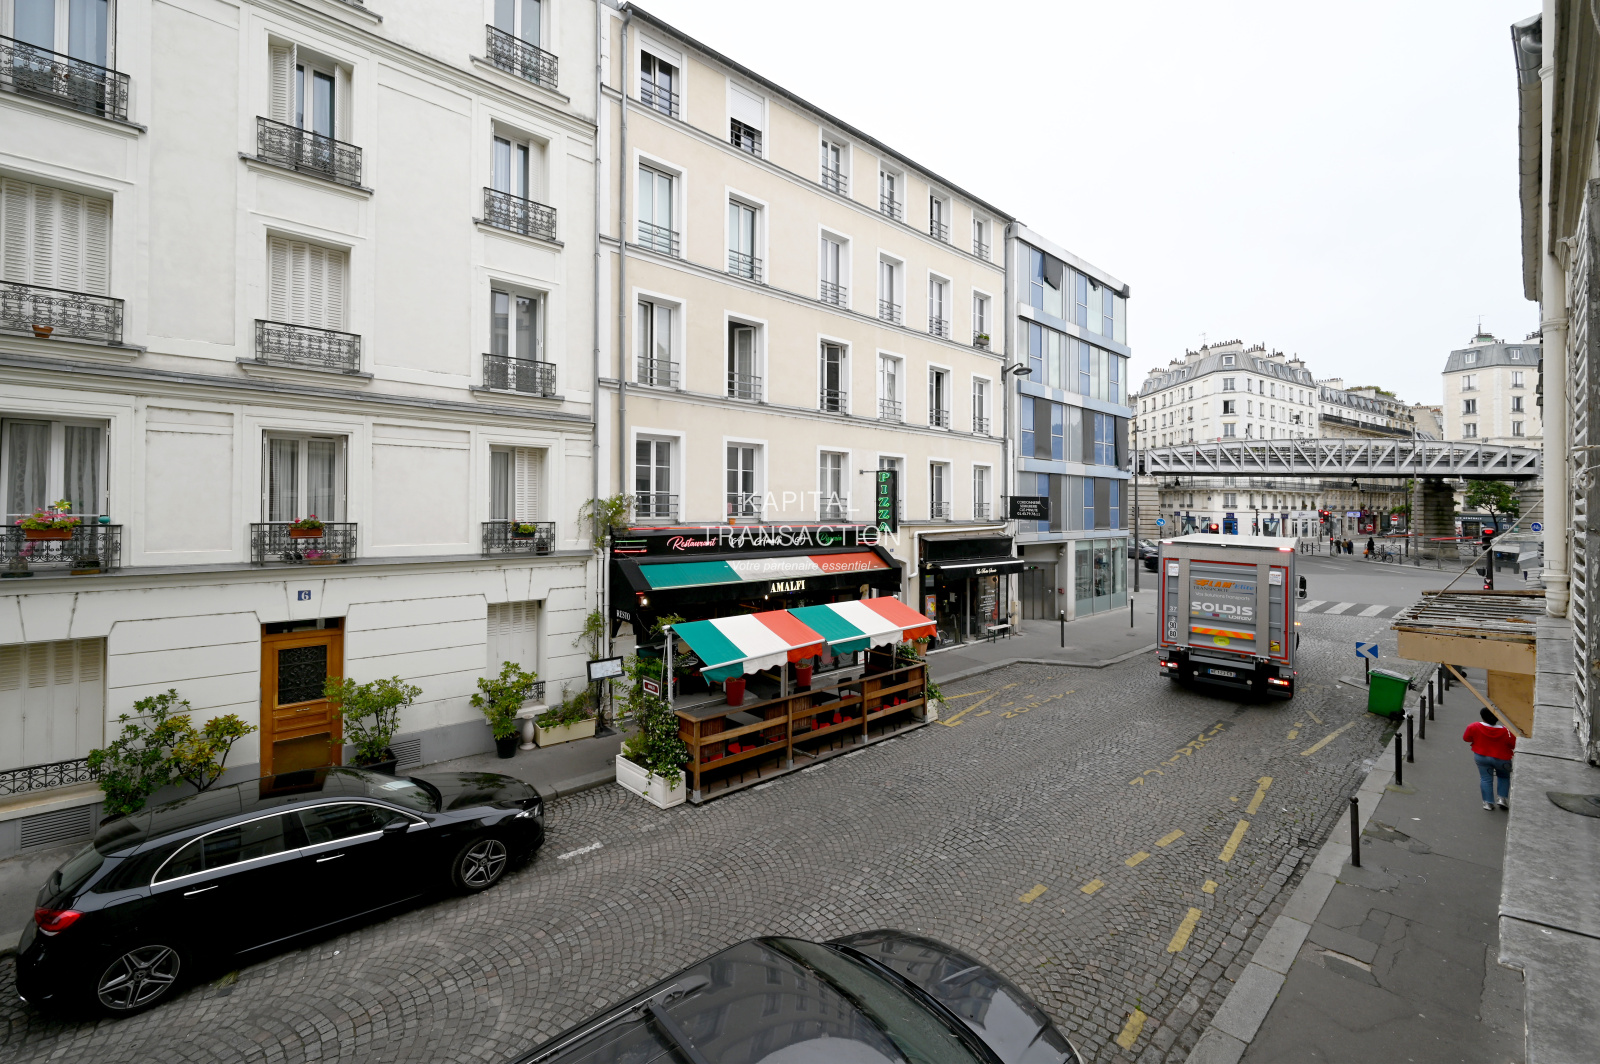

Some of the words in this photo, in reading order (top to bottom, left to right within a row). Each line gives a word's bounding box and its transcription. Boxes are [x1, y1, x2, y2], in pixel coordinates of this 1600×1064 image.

[878, 472, 892, 531] PIZZA
[666, 536, 718, 551] Restaurant
[770, 580, 805, 593] AMALFI
[301, 590, 310, 600] 6
[1191, 601, 1253, 615] SOLDIS
[616, 609, 631, 621] RESTO
